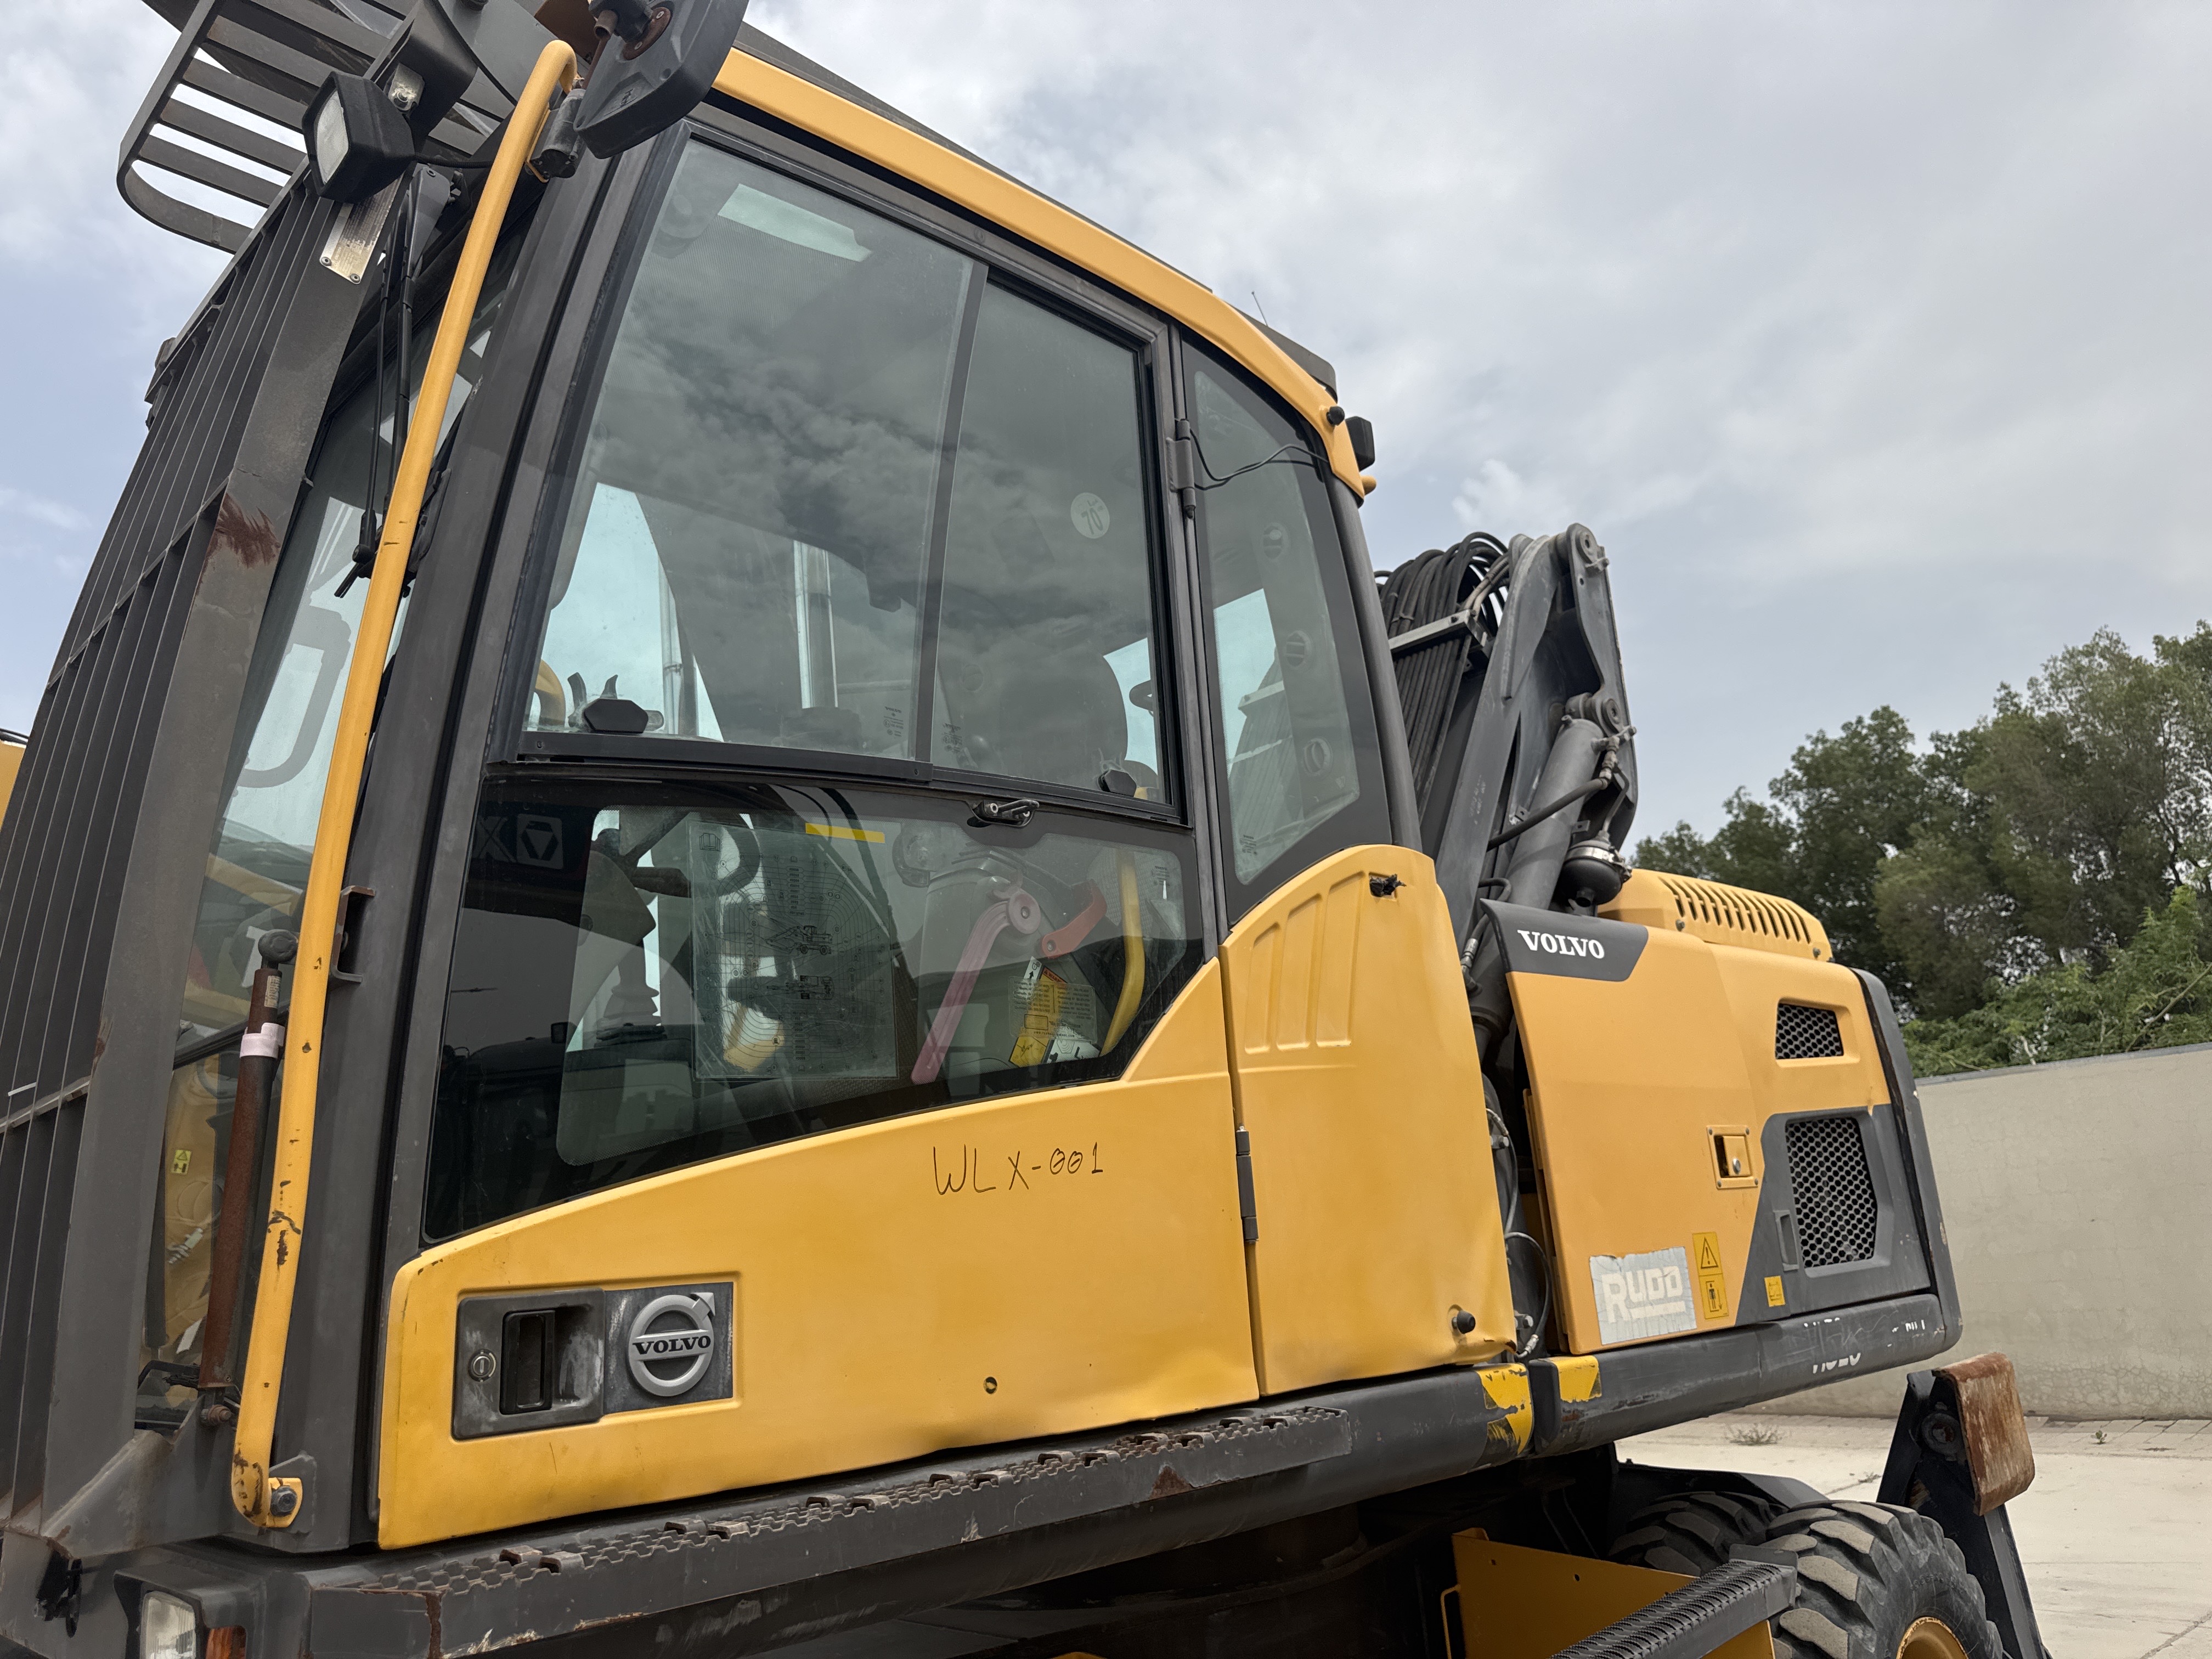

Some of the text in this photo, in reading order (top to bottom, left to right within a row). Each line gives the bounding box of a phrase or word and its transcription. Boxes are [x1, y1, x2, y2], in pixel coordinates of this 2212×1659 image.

[1517, 929, 1605, 959] VOLVO
[1601, 1265, 1684, 1323] RUDD
[632, 1335, 712, 1355] VOLVO
